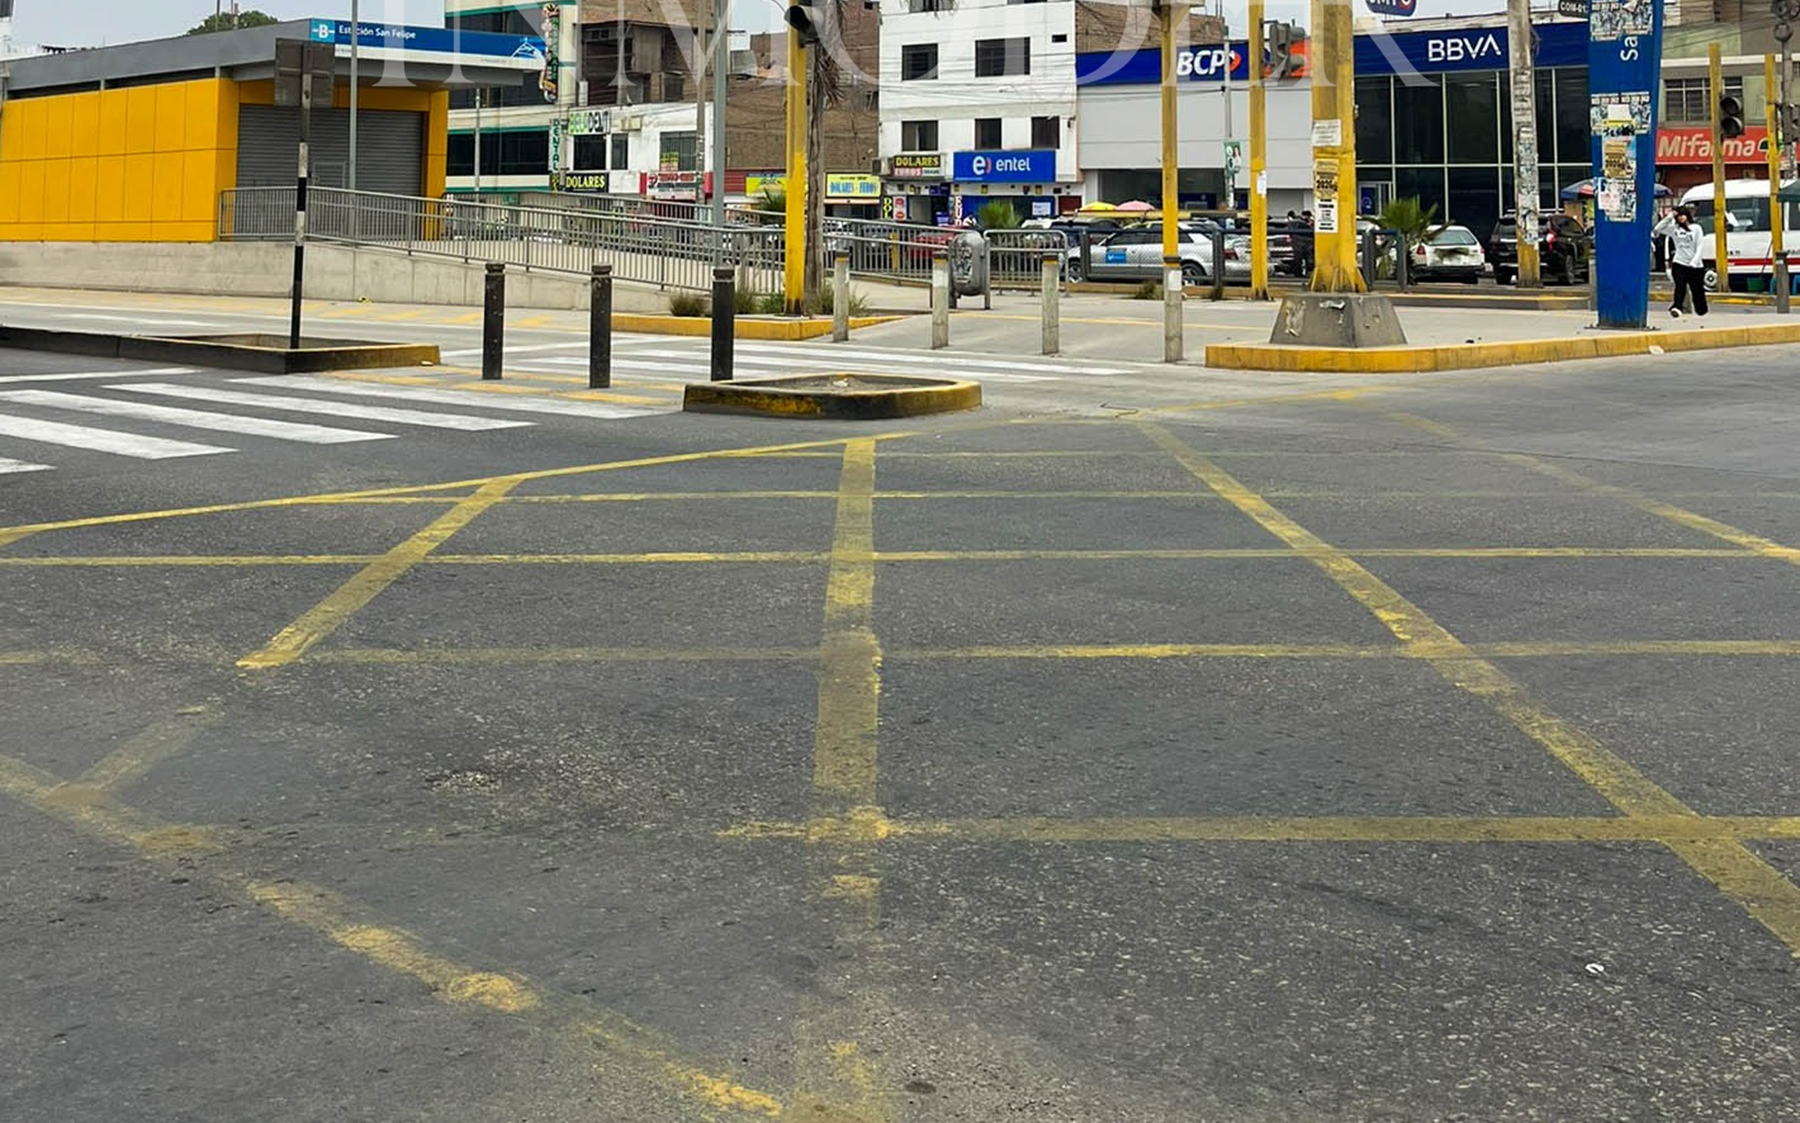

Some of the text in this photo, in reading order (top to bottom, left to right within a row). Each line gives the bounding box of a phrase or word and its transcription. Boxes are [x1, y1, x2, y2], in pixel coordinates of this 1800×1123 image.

[1428, 33, 1502, 62] BBVA
[1620, 36, 1639, 62] Sa
[1176, 50, 1227, 76] BCP
[552, 118, 560, 171] DENTAL
[1658, 133, 1754, 159] Mifama
[895, 156, 939, 167] DOLARES
[996, 157, 1031, 171] entel
[566, 176, 606, 188] DOLARES
